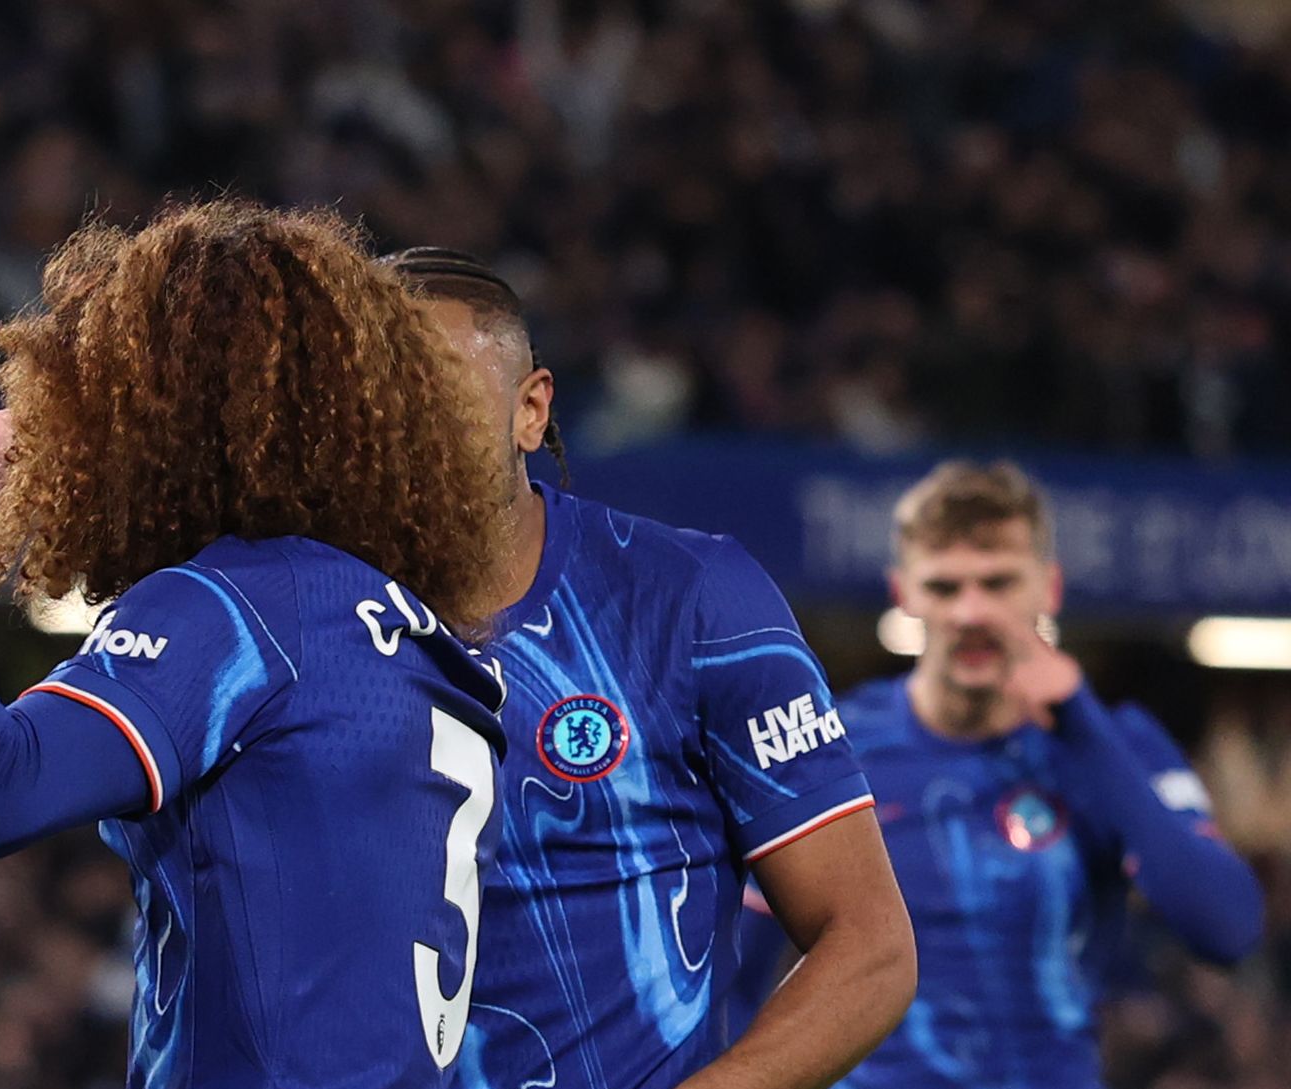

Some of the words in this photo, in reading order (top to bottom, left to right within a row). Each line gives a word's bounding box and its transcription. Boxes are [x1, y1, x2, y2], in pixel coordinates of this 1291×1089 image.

[554, 700, 609, 717] CHELSEA
[747, 692, 817, 745] LIVE
[413, 706, 495, 1071] 3
